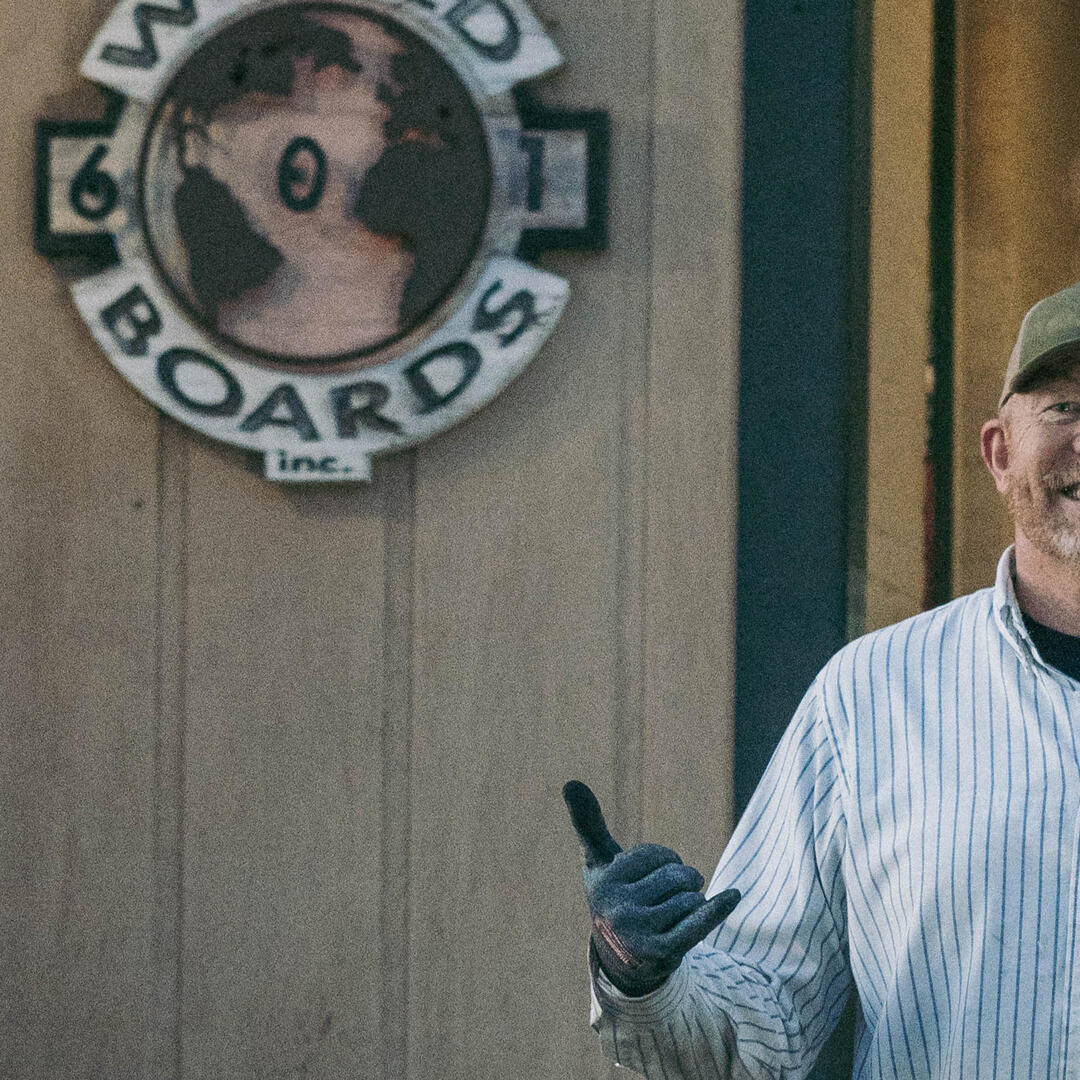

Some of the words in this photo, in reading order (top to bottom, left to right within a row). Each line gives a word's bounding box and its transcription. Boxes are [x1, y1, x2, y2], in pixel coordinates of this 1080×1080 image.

[70, 143, 119, 220] 6
[101, 280, 538, 441] BOARDS
[278, 449, 352, 473] inc.
